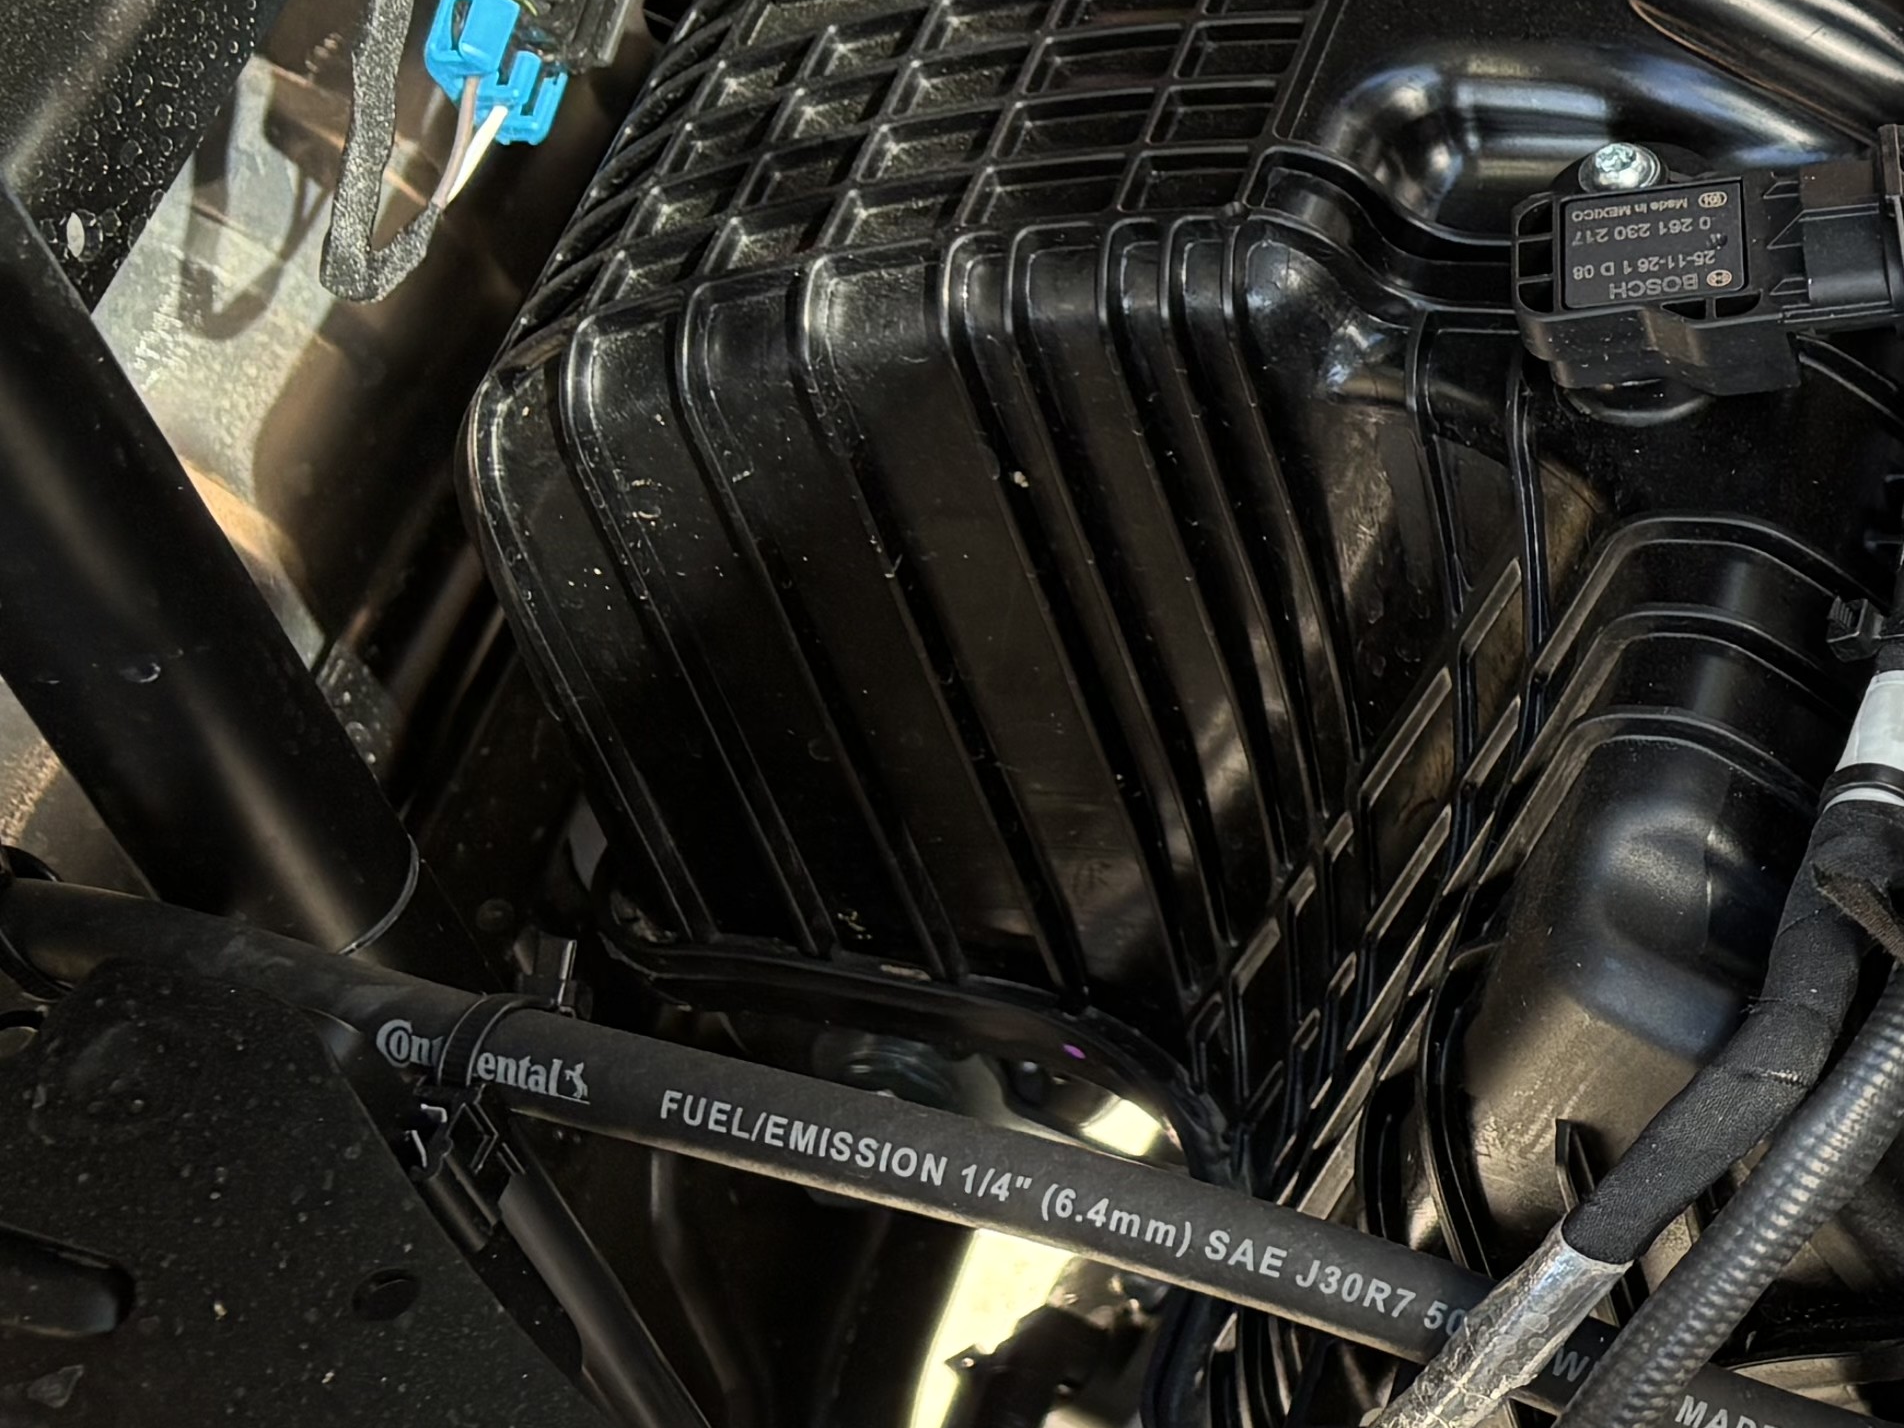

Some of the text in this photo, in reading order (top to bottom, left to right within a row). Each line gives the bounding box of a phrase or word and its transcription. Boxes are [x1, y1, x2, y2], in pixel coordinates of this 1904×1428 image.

[1572, 205, 1631, 222] MEXICO
[1650, 197, 1688, 211] Made
[1572, 217, 1711, 246] 0 261 230 217
[1601, 262, 1614, 276] D
[1637, 250, 1716, 273] 25-11-26
[1573, 265, 1595, 280] 08
[1609, 273, 1698, 299] BOSCH
[376, 1019, 563, 1097] Contental
[660, 1090, 948, 1187] FUEL/EMISSION
[1041, 1183, 1193, 1258] (6.4mm)
[1204, 1230, 1288, 1278] SAE
[1295, 1260, 1416, 1319] J30R7
